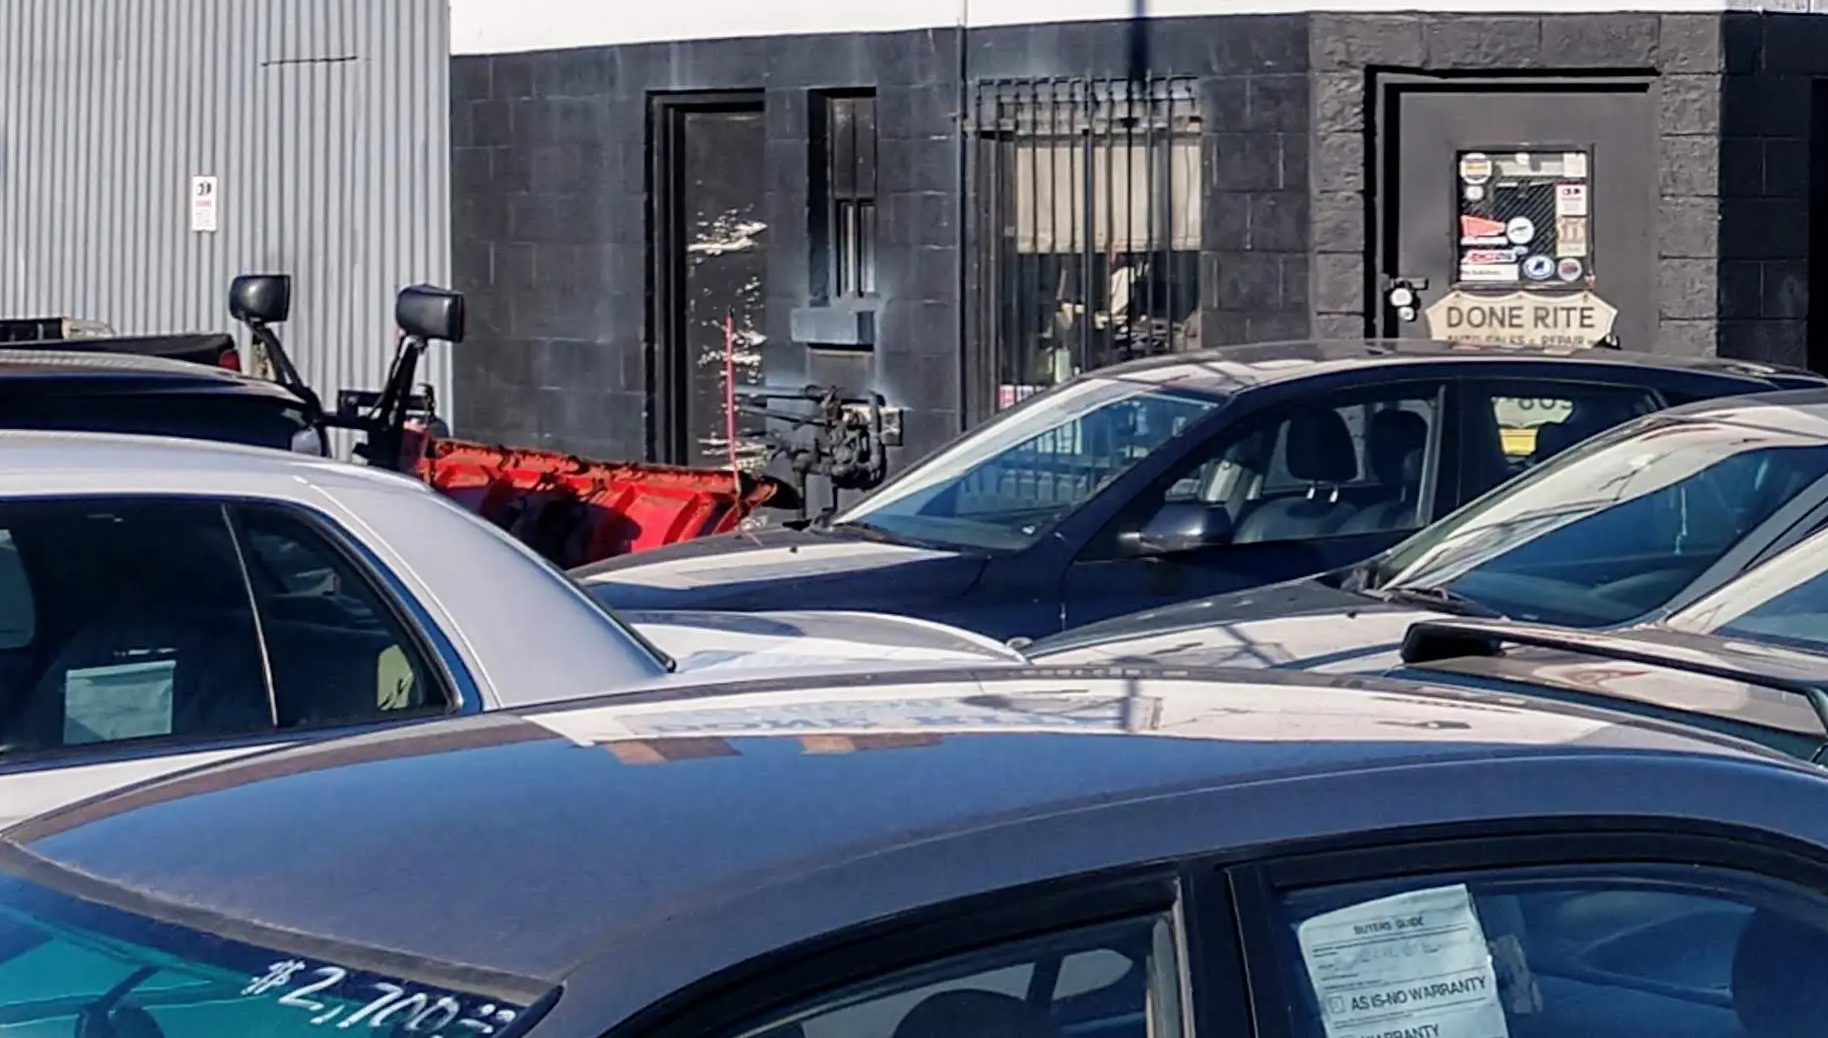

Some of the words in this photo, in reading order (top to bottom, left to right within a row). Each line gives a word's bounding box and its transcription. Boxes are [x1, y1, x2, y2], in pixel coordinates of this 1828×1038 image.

[1446, 306, 1524, 329] DONE
[1533, 307, 1595, 329] RITE
[1408, 975, 1487, 1003] WARRANTY
